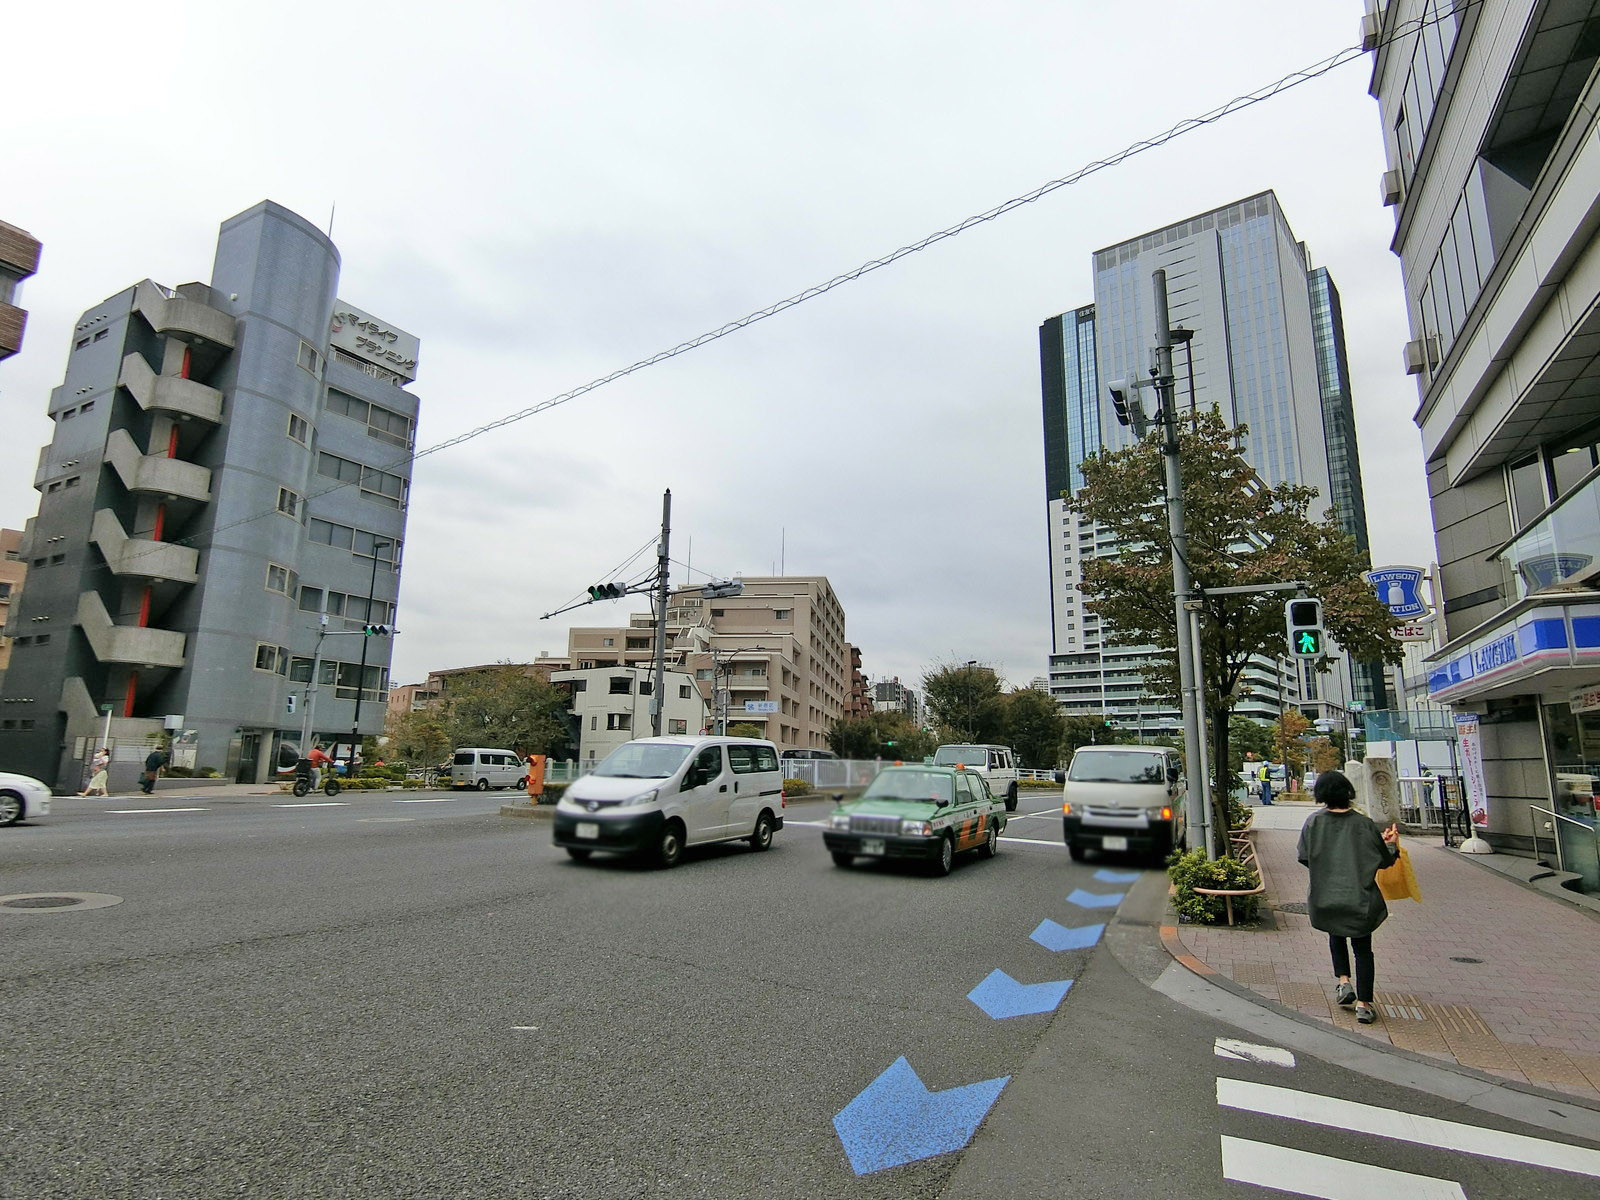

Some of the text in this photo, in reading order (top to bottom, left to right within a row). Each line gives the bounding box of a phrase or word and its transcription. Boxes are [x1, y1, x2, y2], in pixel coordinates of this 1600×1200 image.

[348, 313, 398, 344] マイライフ
[355, 335, 418, 370] プランニング
[1373, 573, 1415, 583] LAWSON
[1389, 603, 1419, 613] ATION
[1394, 626, 1424, 637] たばこ
[1475, 634, 1517, 674] LAWSON
